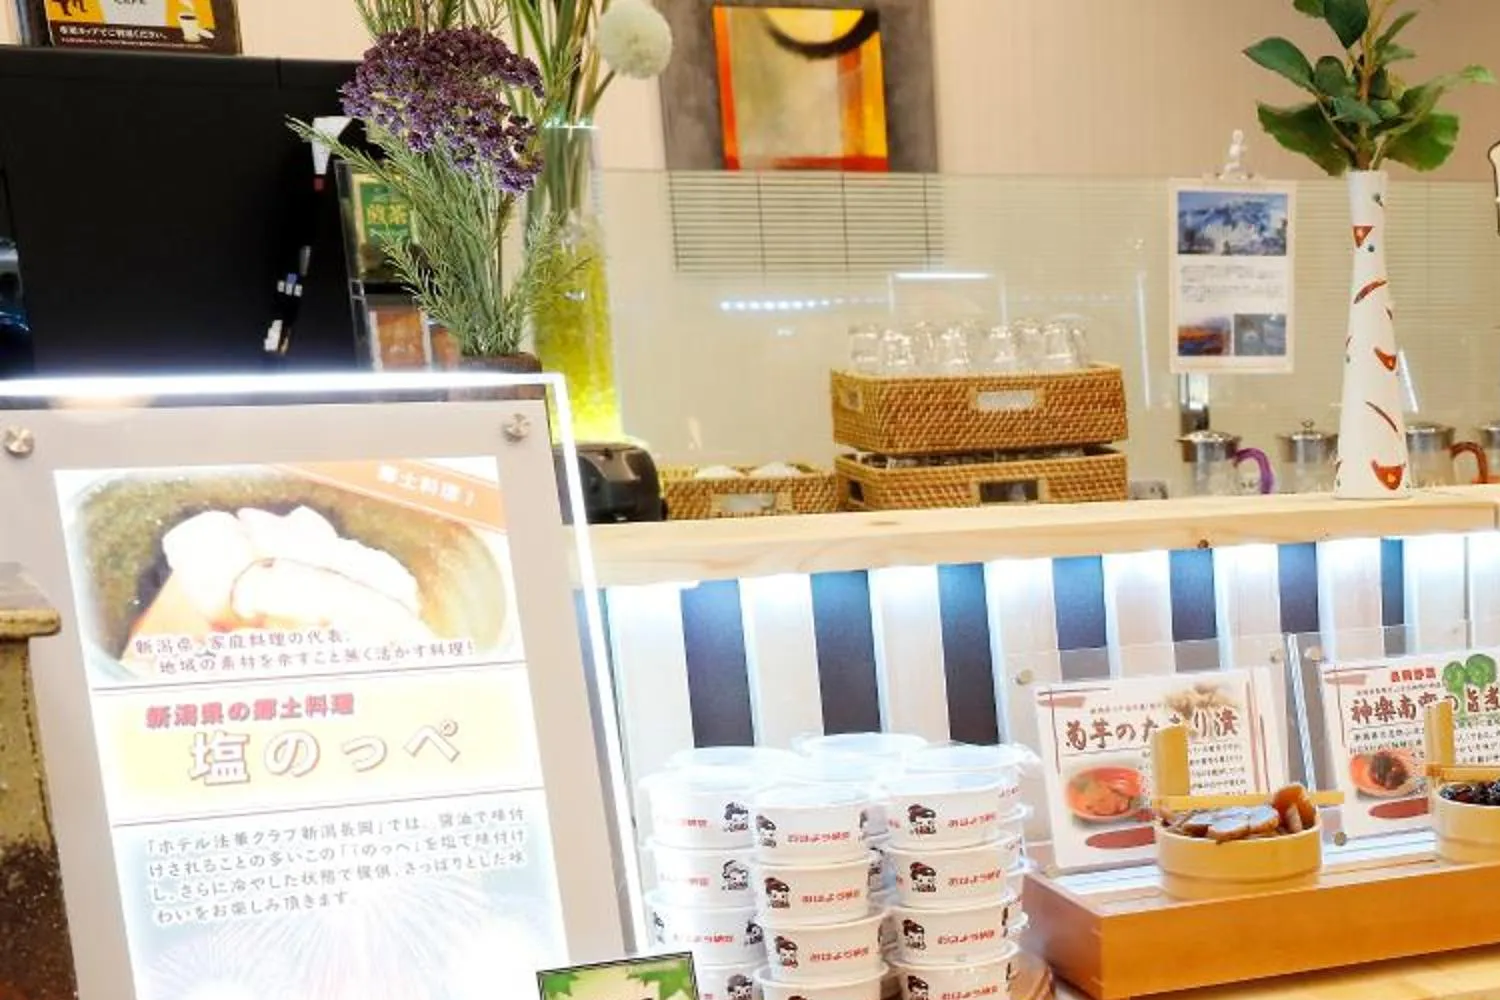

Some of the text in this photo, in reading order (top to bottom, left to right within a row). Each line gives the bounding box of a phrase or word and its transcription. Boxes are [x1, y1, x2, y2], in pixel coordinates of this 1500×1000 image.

[145, 692, 355, 729] 新潟県の郷土料理
[188, 718, 461, 787] 塩のっぺ
